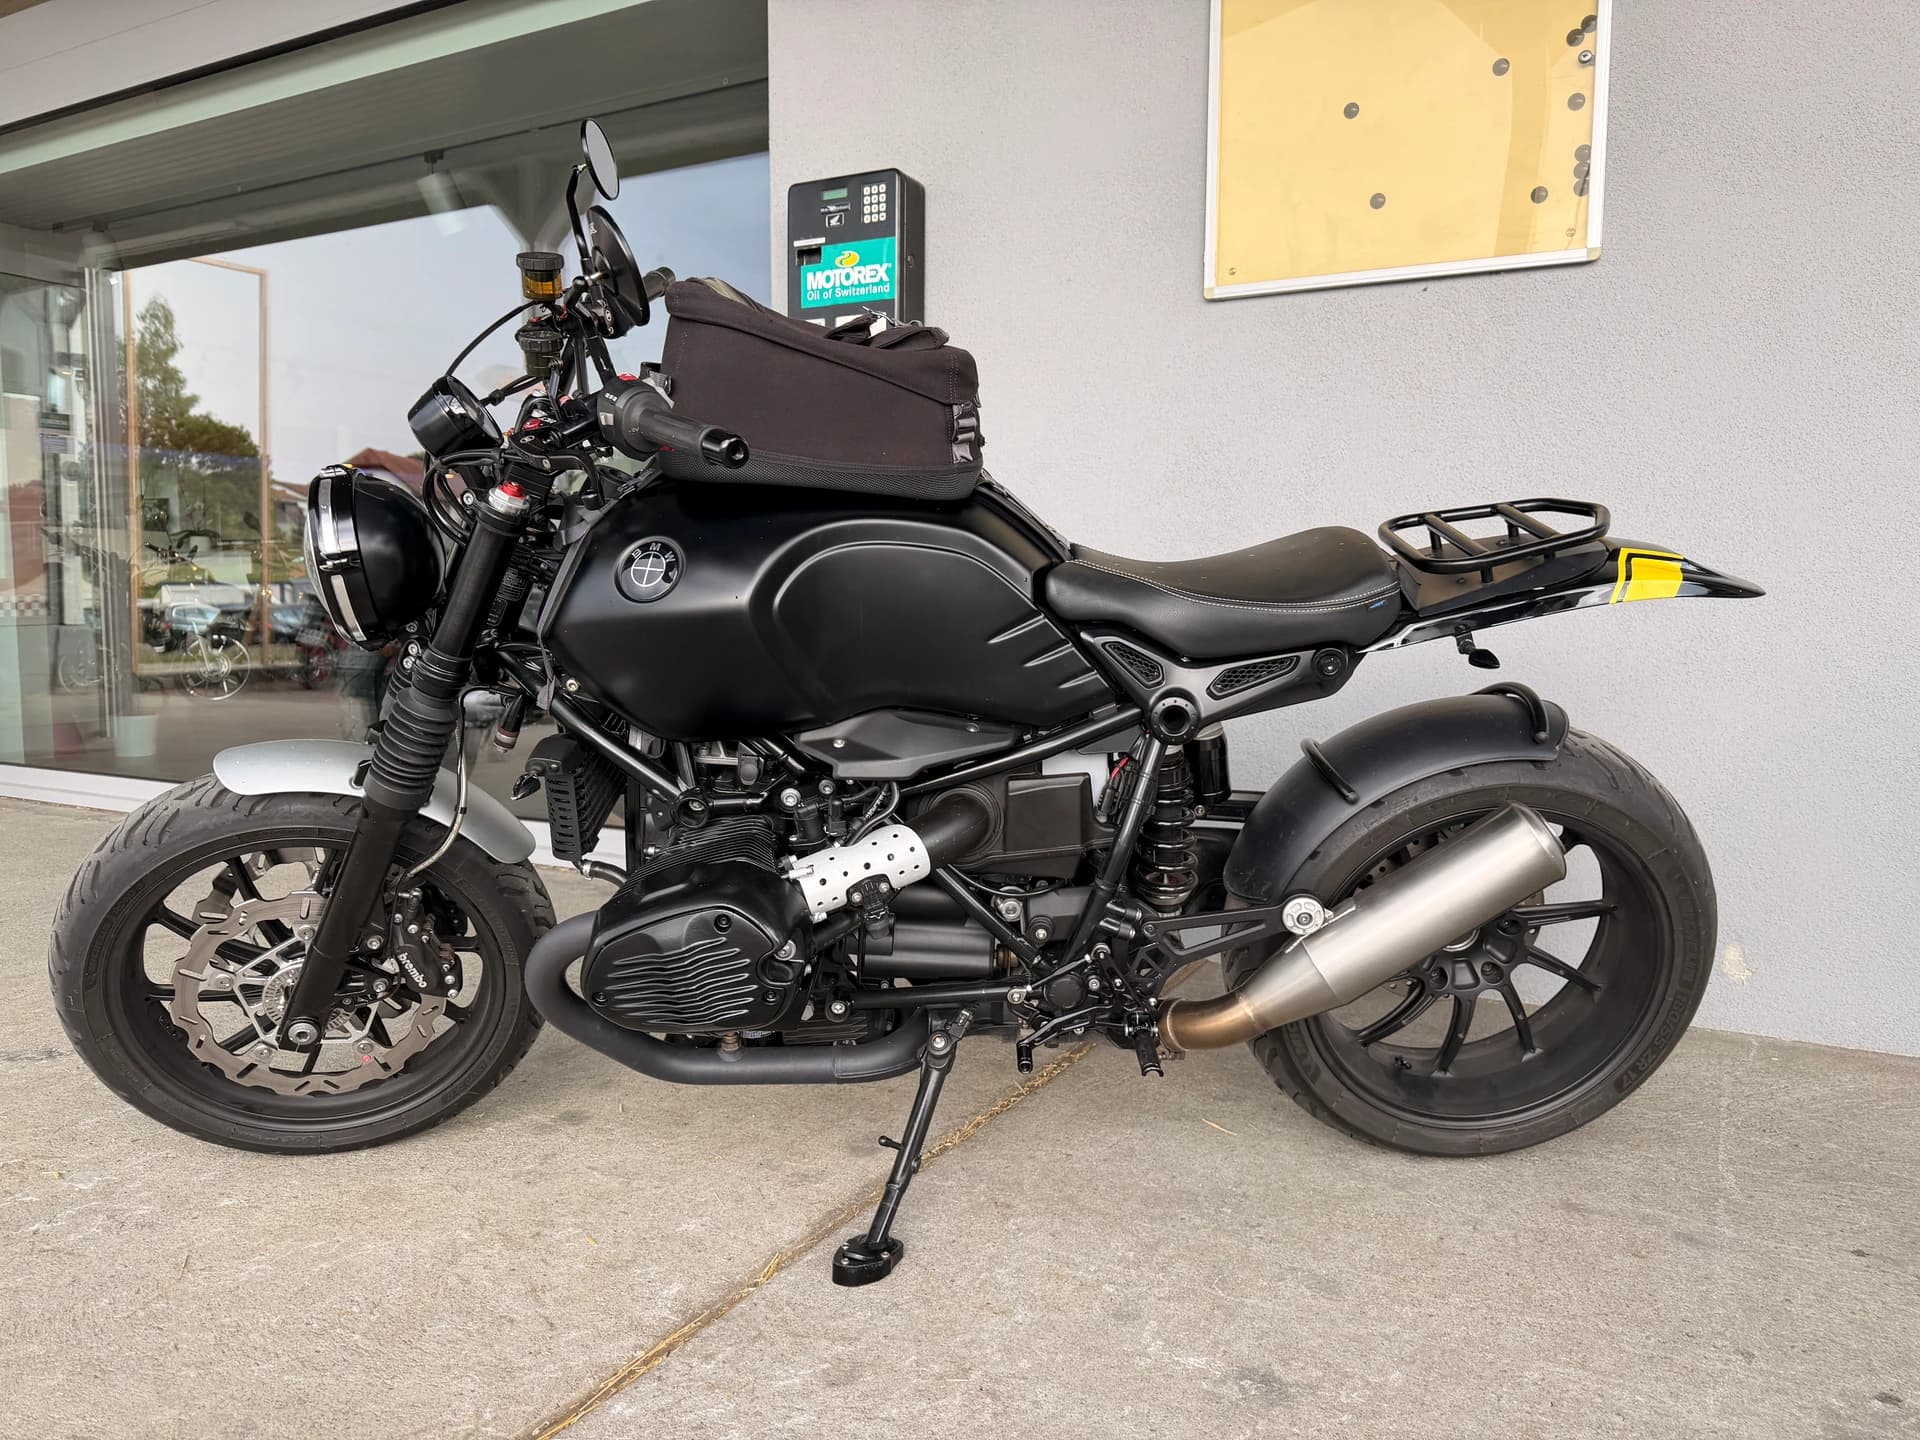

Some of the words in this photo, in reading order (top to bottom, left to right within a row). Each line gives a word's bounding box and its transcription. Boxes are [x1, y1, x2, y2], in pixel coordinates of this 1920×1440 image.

[807, 263, 889, 290] MOTOREX
[807, 290, 820, 301] Oil
[823, 288, 833, 299] of
[835, 282, 890, 298] Switzerland
[631, 542, 676, 562] BMW
[398, 952, 428, 988] brembo
